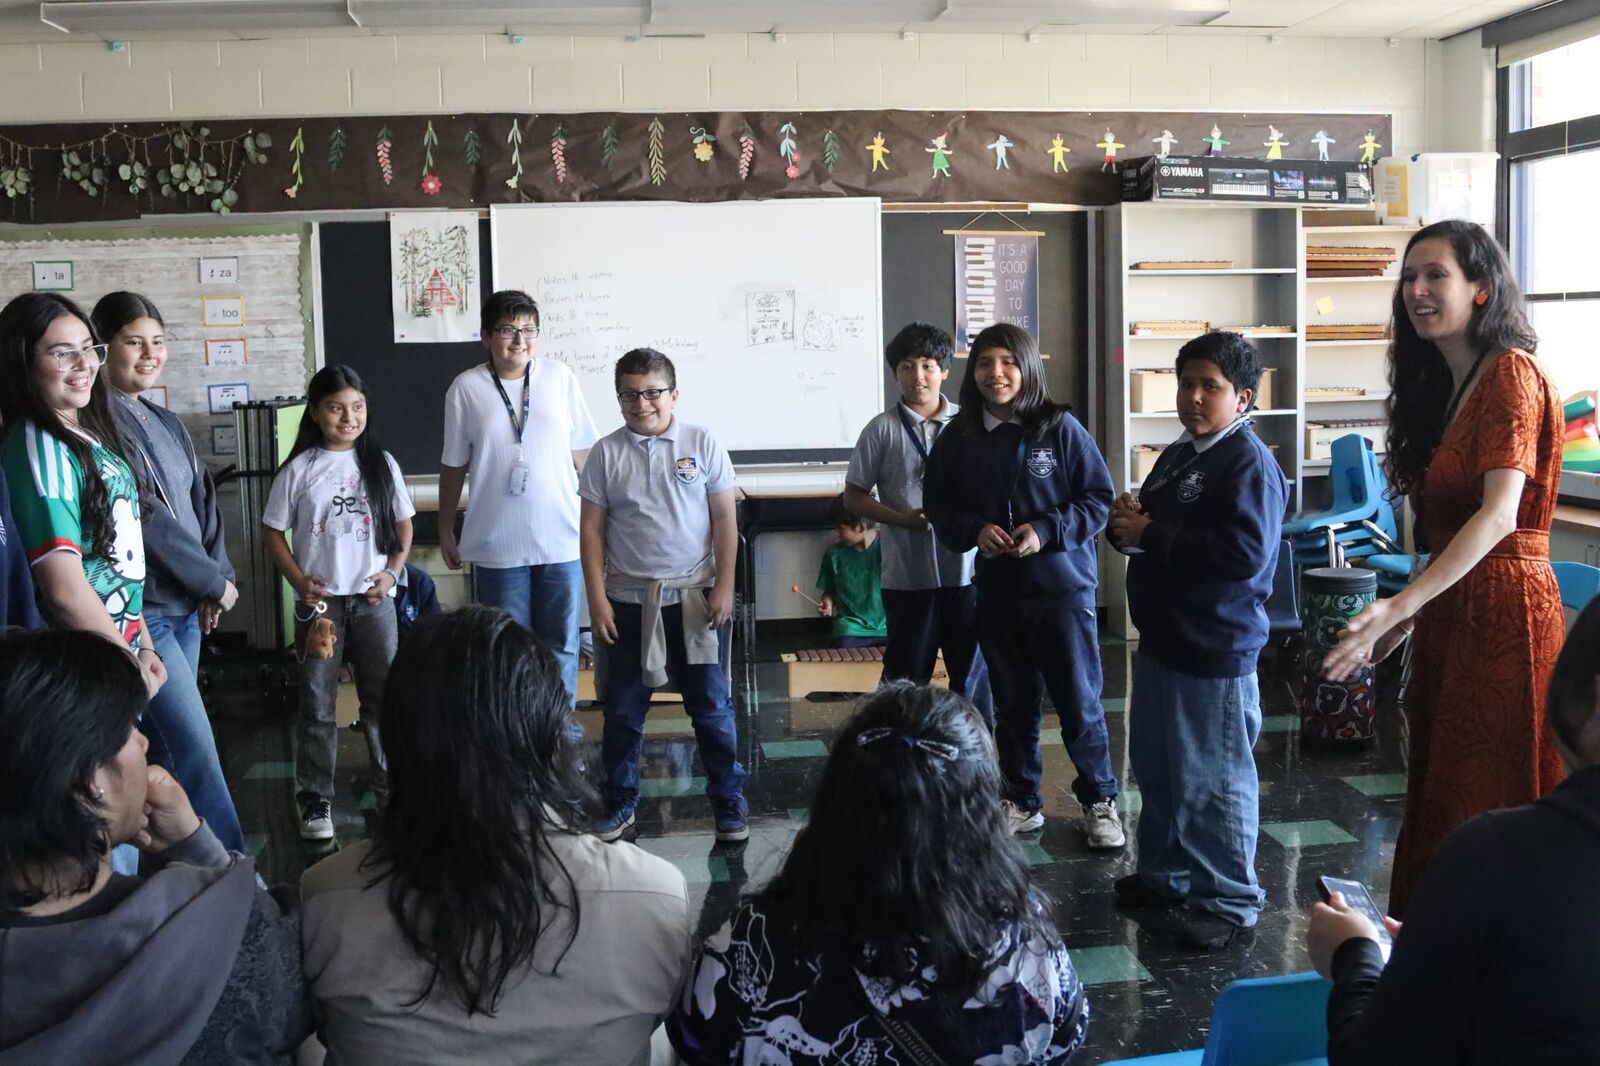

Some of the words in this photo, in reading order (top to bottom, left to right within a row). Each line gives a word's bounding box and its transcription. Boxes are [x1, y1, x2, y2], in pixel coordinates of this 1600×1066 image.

[1170, 167, 1204, 177] YAMAHA
[998, 243, 1015, 256] IT'S
[1020, 243, 1028, 256] A
[999, 261, 1028, 274] GOOD
[54, 271, 65, 280] ta
[219, 269, 232, 278] za
[1005, 279, 1025, 292] DAY
[1009, 297, 1023, 310] TO
[222, 308, 239, 318] too
